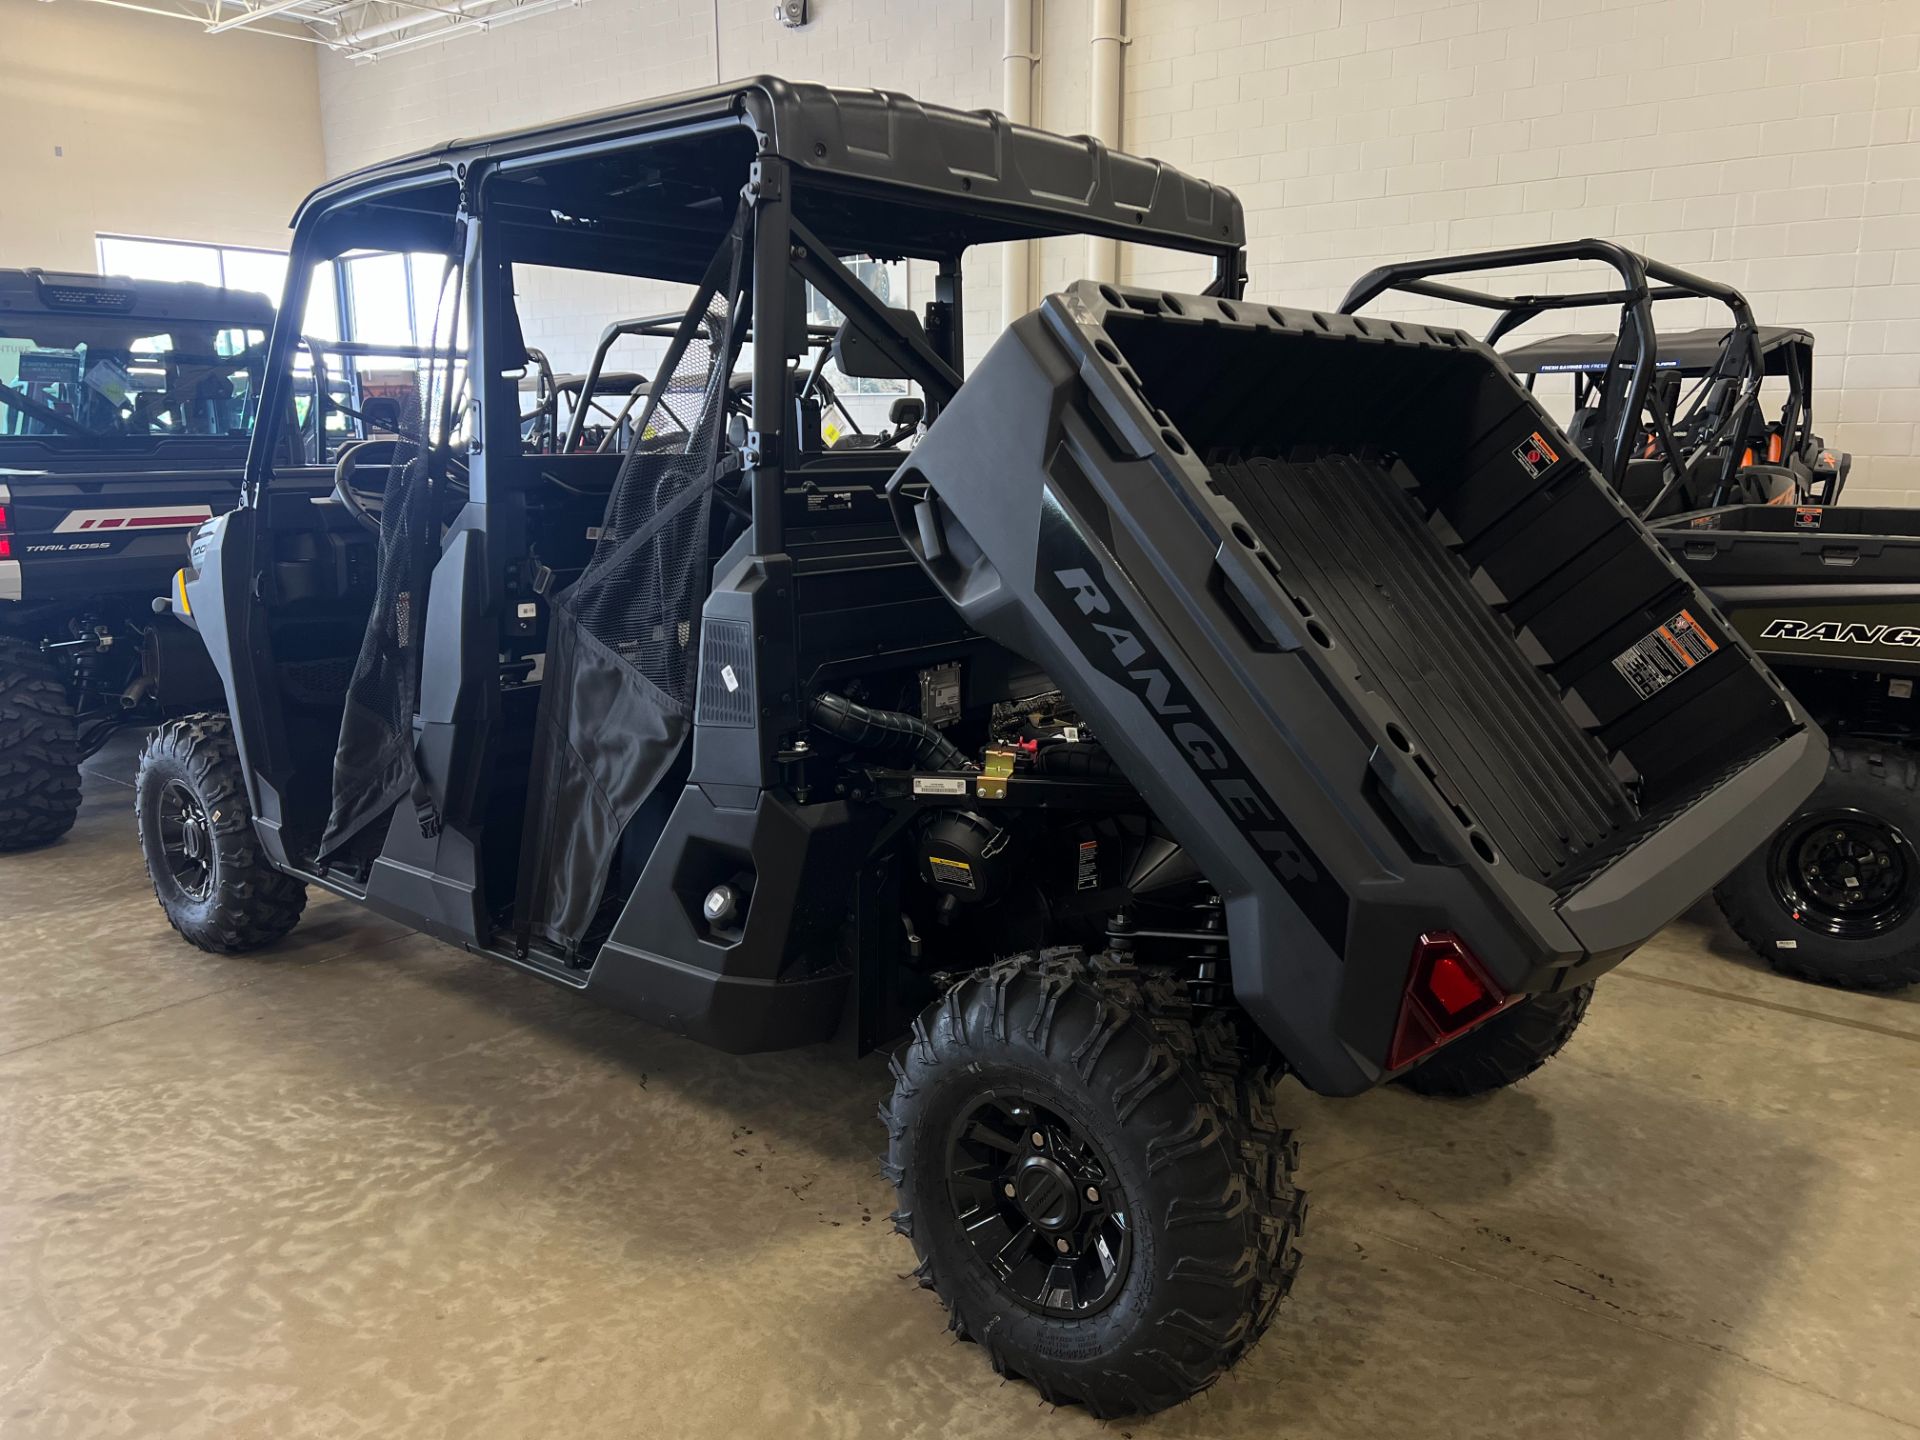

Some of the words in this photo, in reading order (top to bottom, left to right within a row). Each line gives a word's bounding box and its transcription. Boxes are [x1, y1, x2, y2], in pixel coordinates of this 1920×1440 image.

[26, 544, 66, 552] TRAIL
[68, 542, 111, 550] BOSS
[1760, 619, 1920, 647] RANG
[1053, 567, 1318, 883] RANGER
